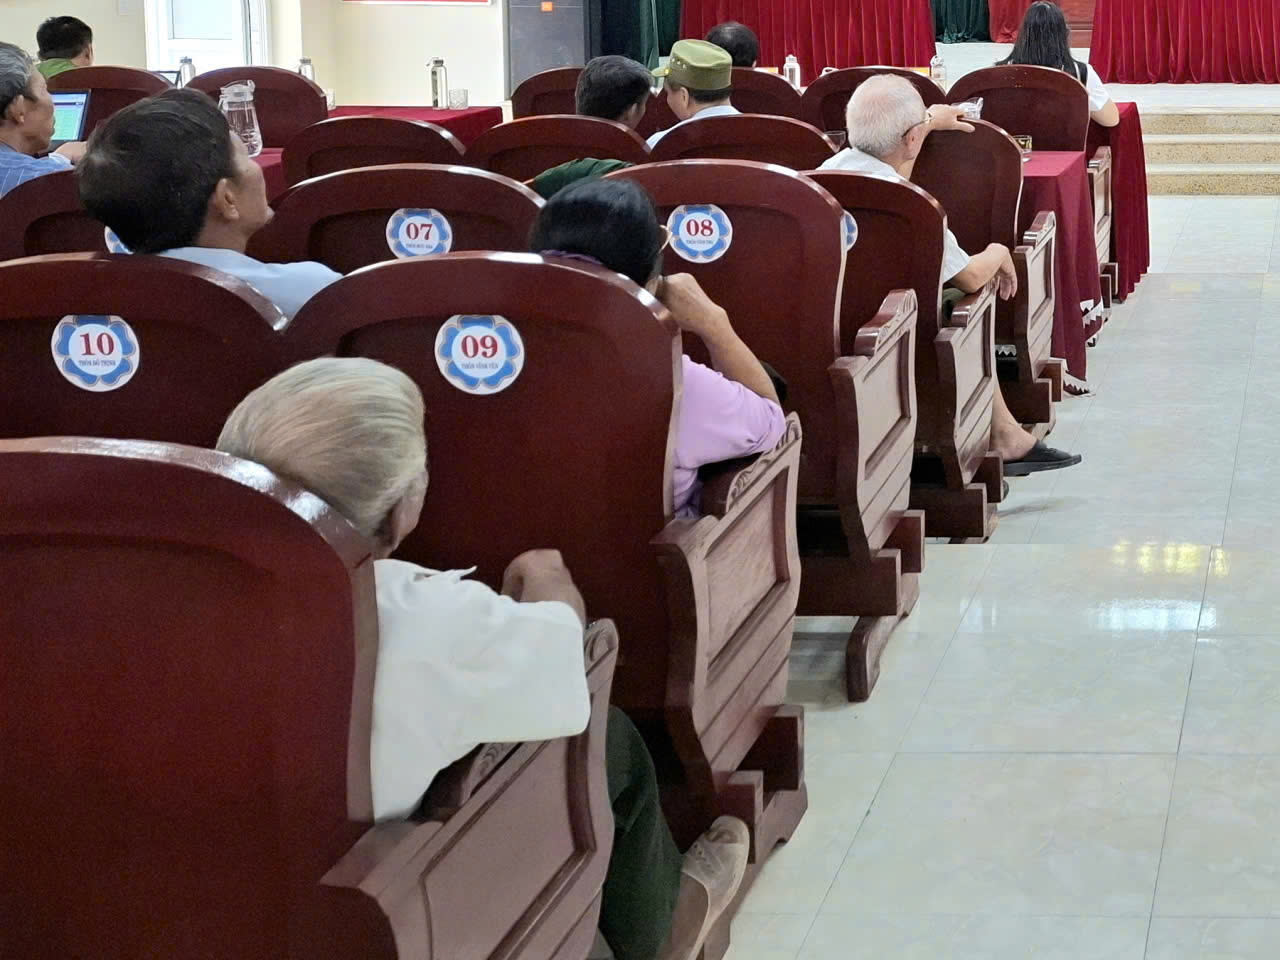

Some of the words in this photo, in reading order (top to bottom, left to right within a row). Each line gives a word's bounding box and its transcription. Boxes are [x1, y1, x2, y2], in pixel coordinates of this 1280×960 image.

[406, 223, 432, 240] 07
[686, 219, 713, 236] 08
[79, 332, 115, 356] 10
[461, 335, 498, 358] 09
